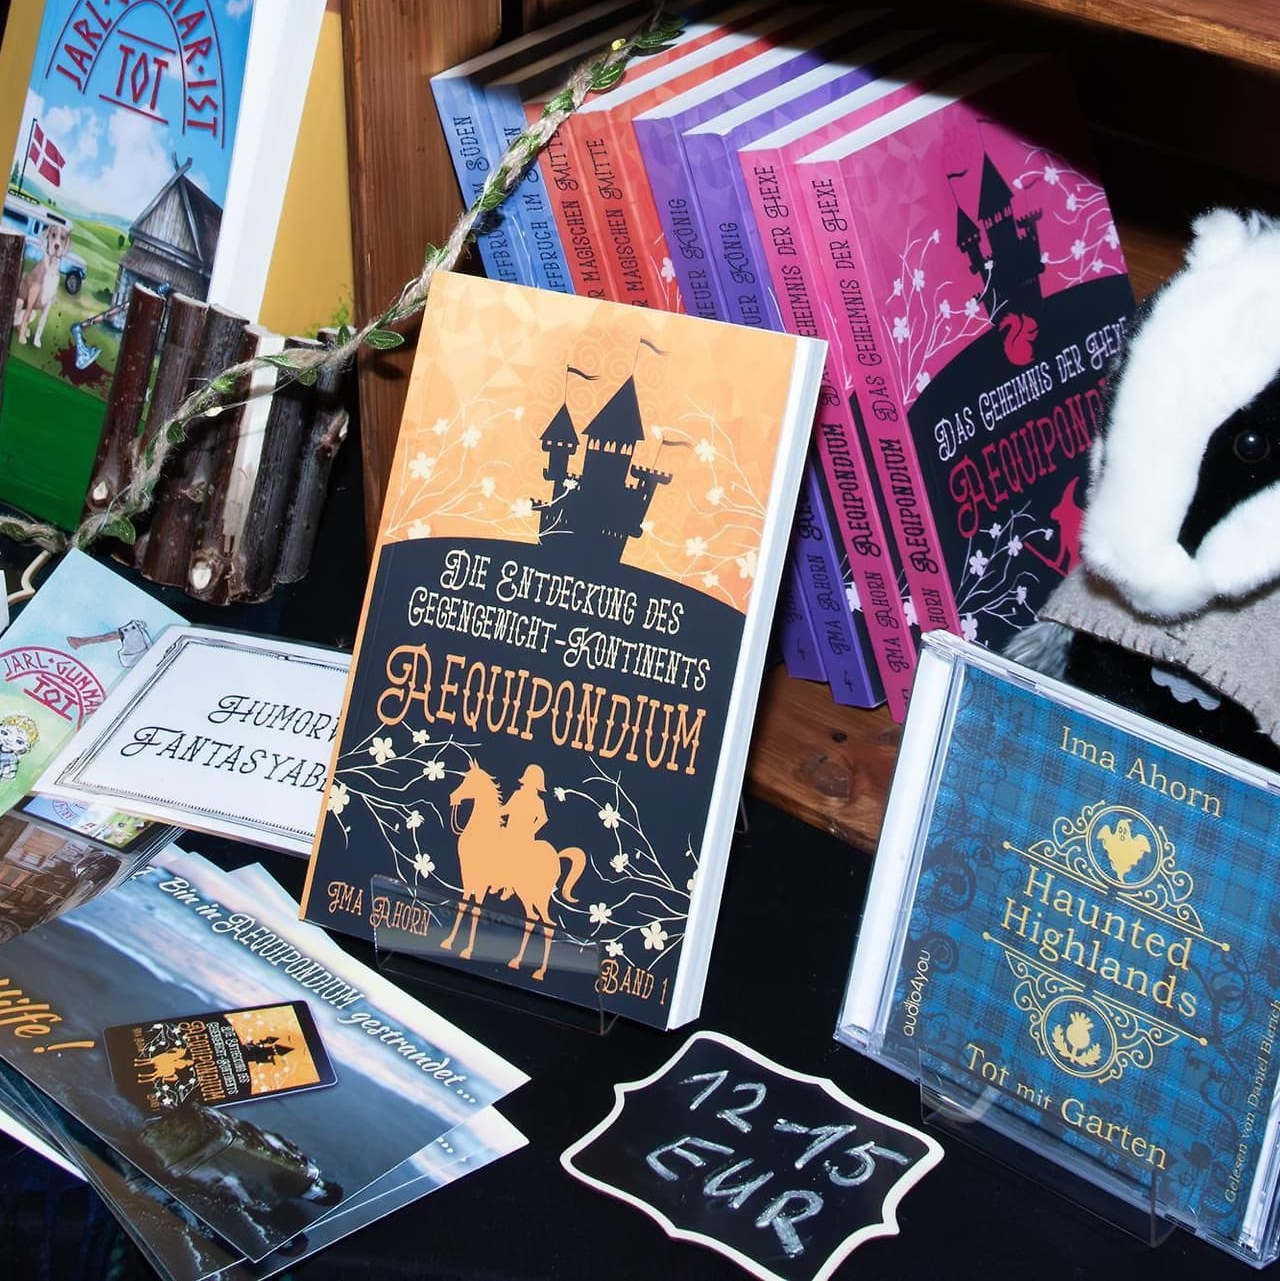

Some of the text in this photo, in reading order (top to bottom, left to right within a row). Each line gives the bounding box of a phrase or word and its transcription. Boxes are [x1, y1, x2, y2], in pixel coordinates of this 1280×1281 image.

[117, 43, 169, 111] TOT
[439, 548, 684, 635] DIE ENTDECKUNG DES
[376, 643, 707, 775] AEQUIPONDIUM
[1061, 726, 1222, 818] Ima Ahorn
[159, 877, 199, 905] Bin
[197, 901, 223, 921] in
[1024, 866, 1194, 971] Haunted
[903, 950, 931, 1037] audio4you
[1002, 899, 1198, 1018] Highlands
[966, 1043, 1168, 1171] Tot mit Garten
[646, 1135, 825, 1258] EUR
